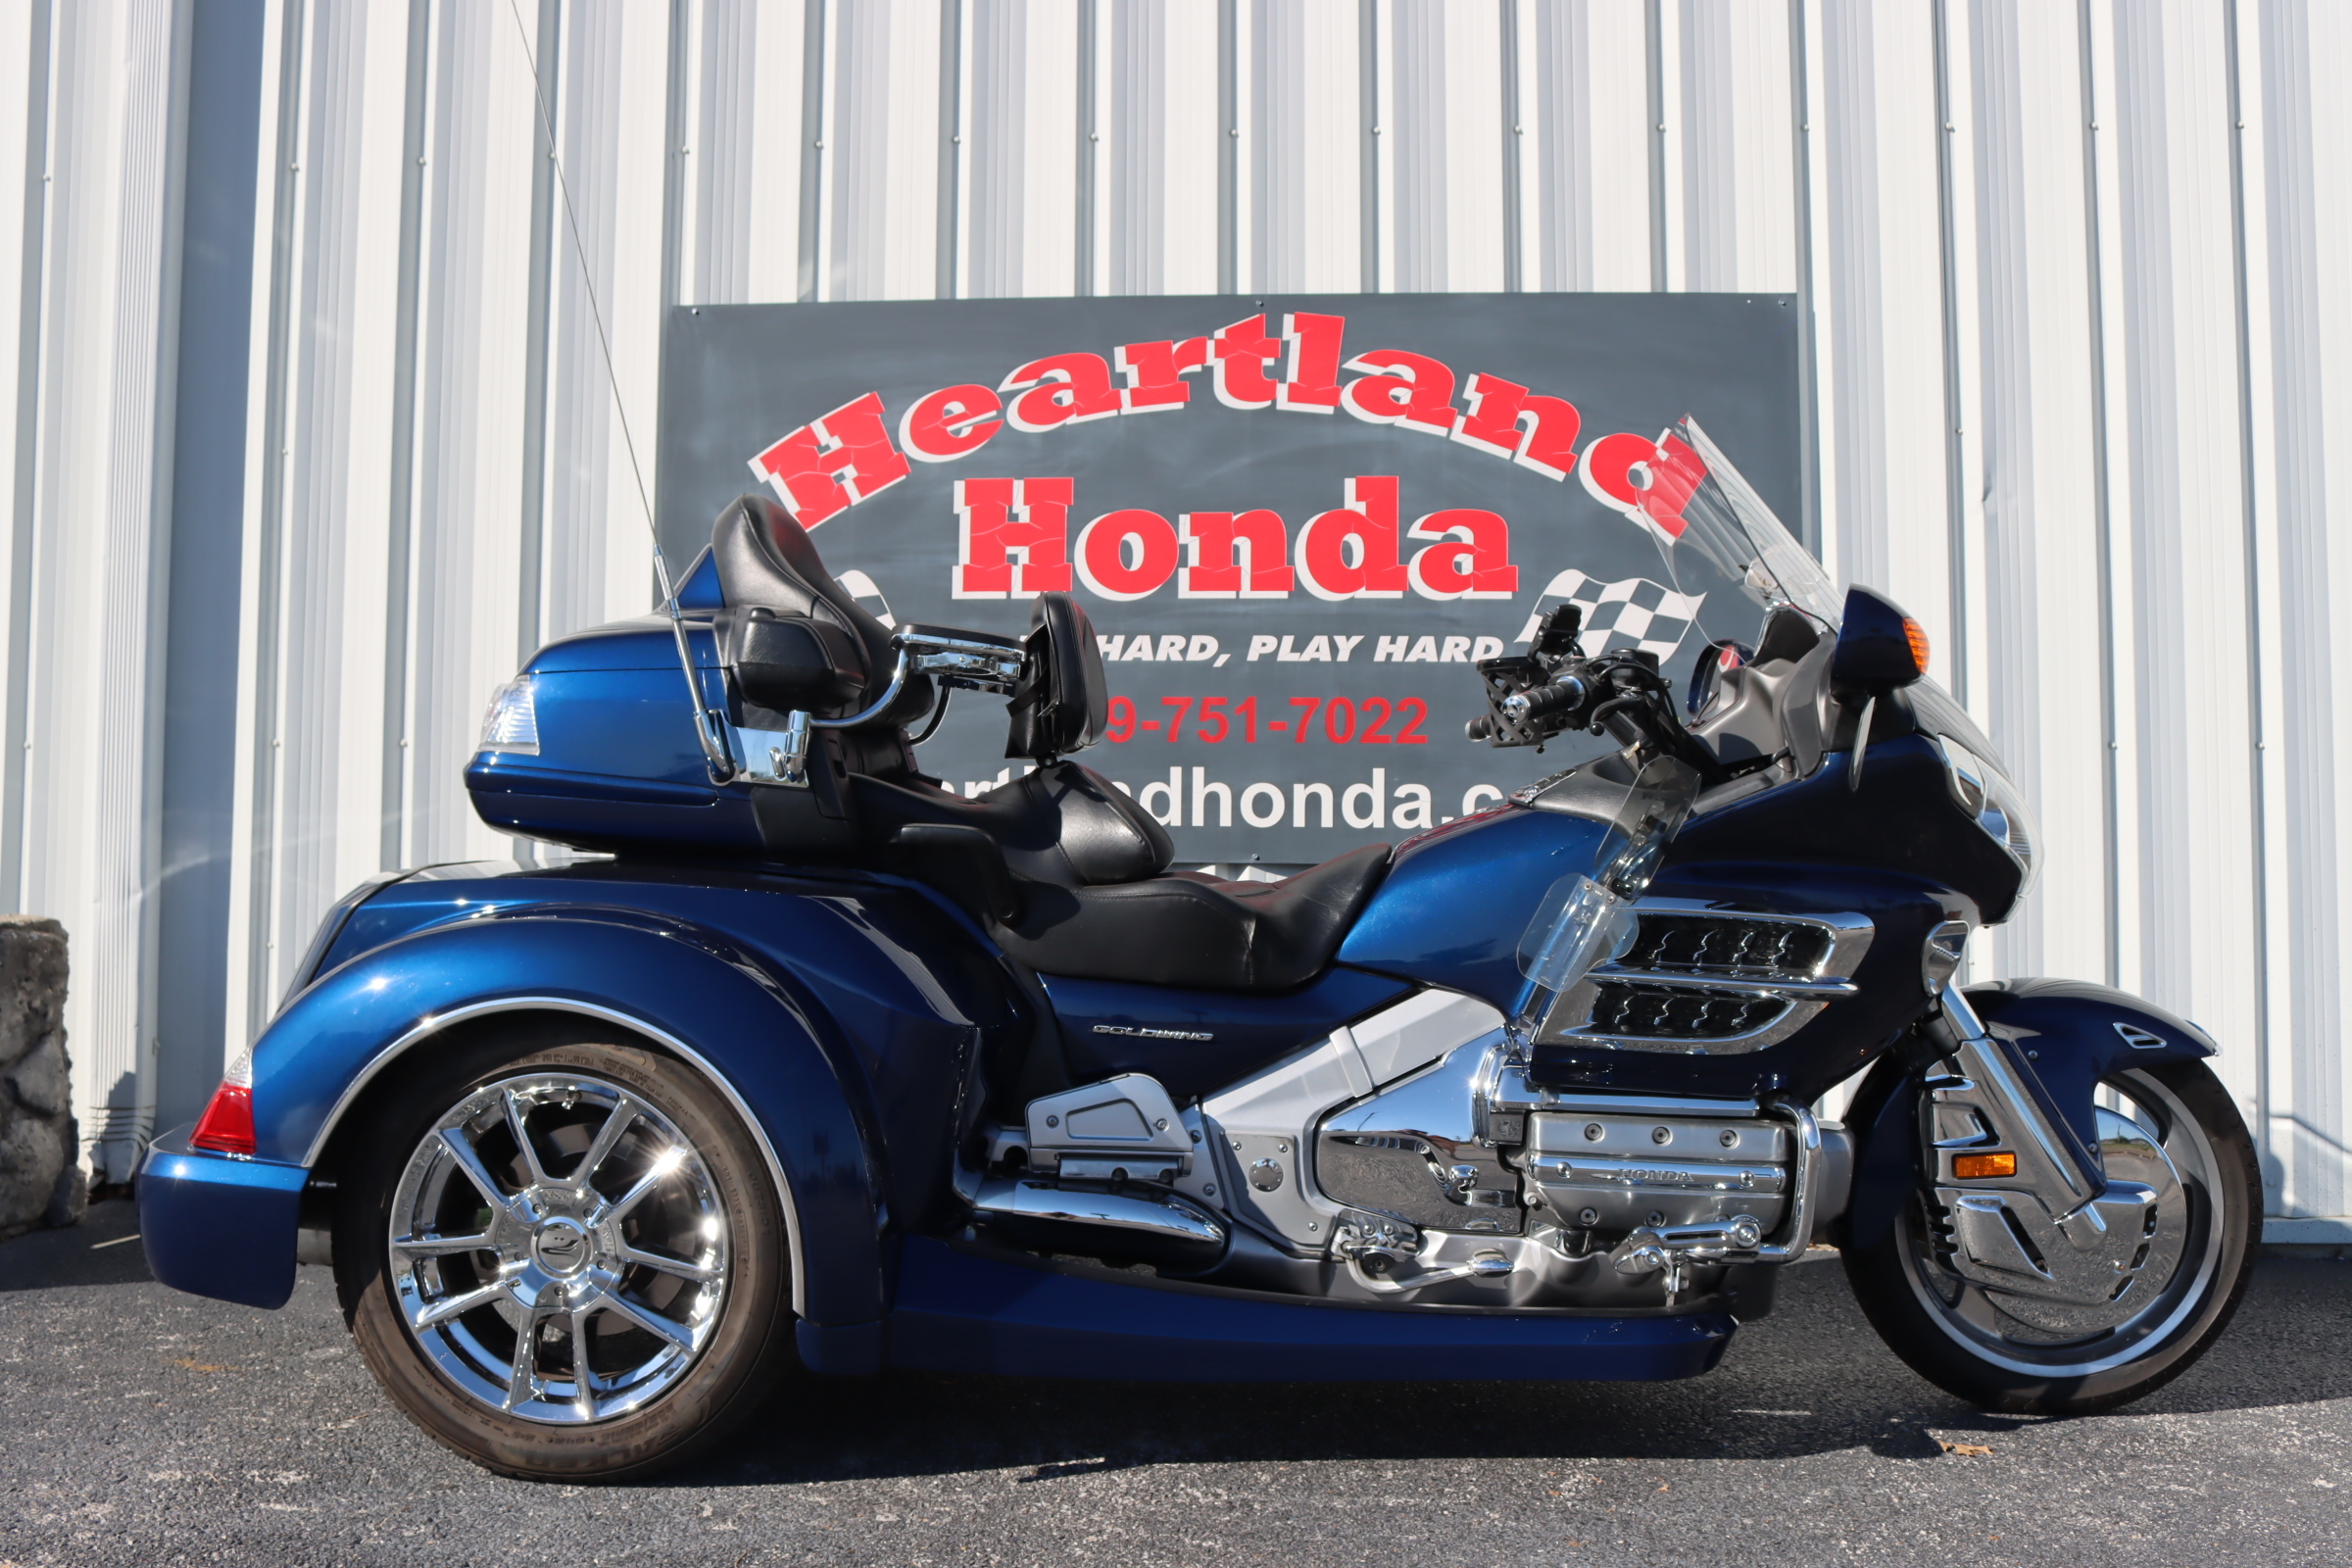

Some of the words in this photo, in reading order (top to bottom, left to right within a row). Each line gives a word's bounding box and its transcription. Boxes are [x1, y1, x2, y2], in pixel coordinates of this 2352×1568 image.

[748, 312, 1707, 546] Heartland
[952, 476, 1518, 601] Honda
[1247, 635, 1364, 662] PLAY
[1374, 636, 1503, 662] HARD
[1105, 696, 1427, 744] 9-751-7022
[1618, 1168, 1694, 1182] HONDA
